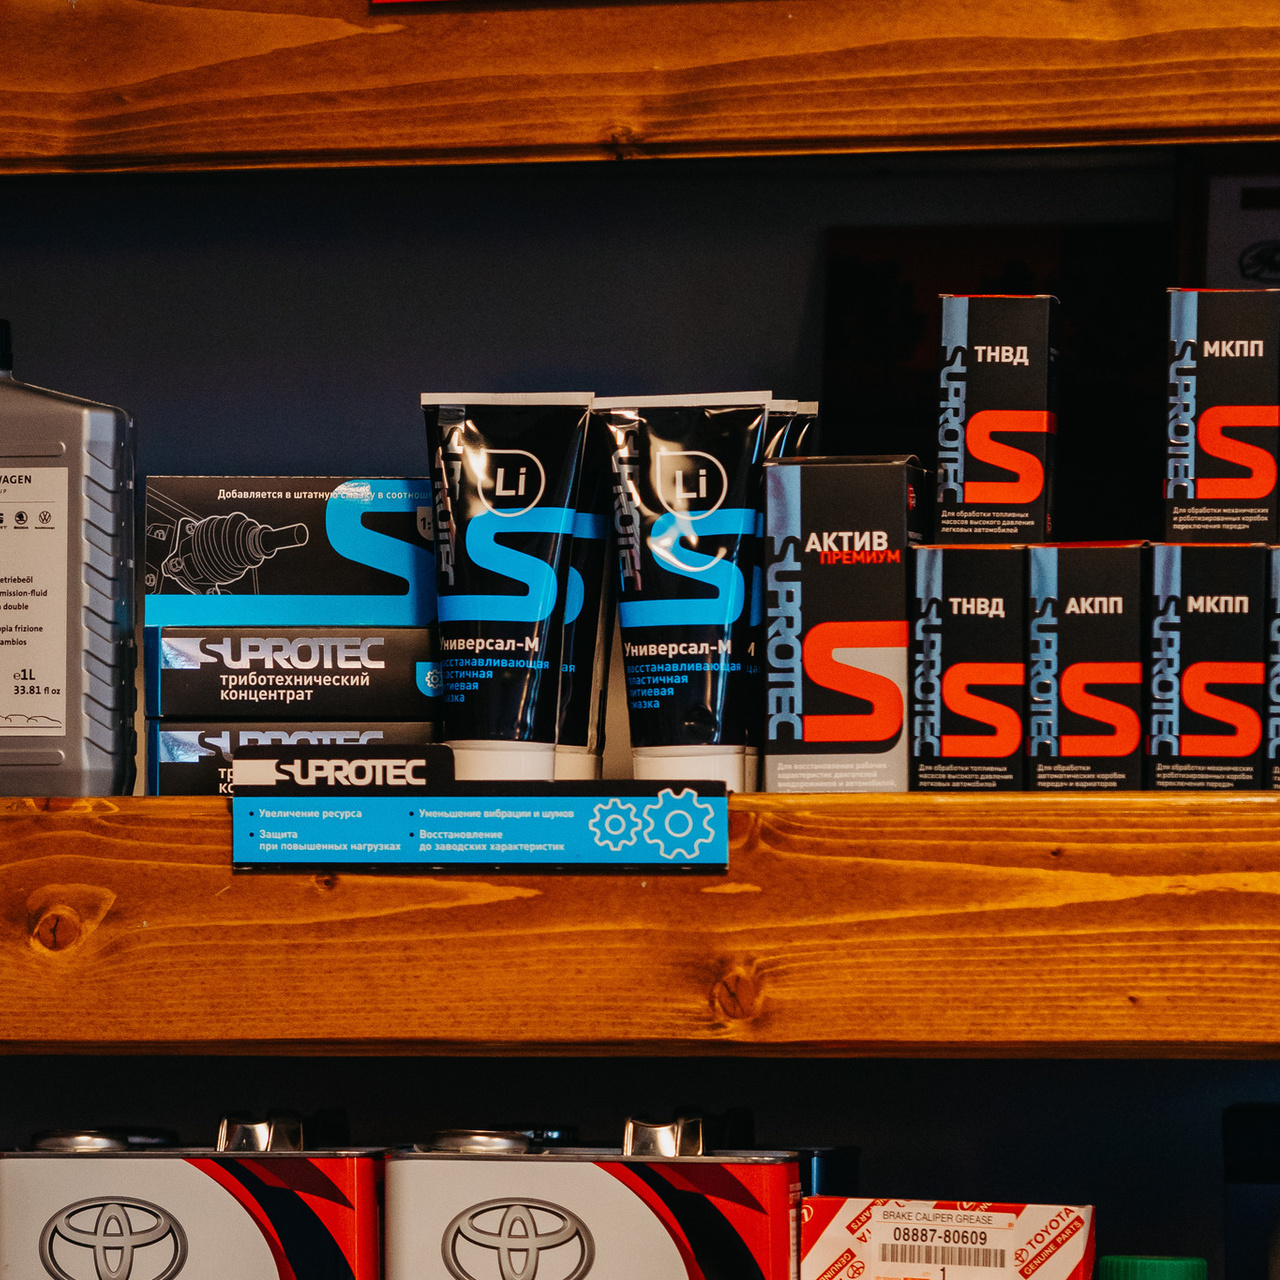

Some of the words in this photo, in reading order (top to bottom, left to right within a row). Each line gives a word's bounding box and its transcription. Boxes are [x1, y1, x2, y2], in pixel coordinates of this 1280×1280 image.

[974, 346, 1029, 366] ТНВД
[1203, 340, 1264, 358] МКПП
[495, 467, 527, 497] Li
[674, 468, 707, 499] Li
[218, 489, 282, 500] Добавляется
[294, 491, 338, 501] штатную
[805, 531, 888, 553] АКТИВ
[820, 549, 901, 564] ПРЕМИУМ
[949, 596, 1005, 618] ТНВД
[1065, 596, 1123, 615] АКПП
[1187, 596, 1249, 614] МКПП
[200, 637, 385, 670] SUPROTEC
[624, 640, 732, 658] Универсал-М
[220, 673, 370, 686] триботехнический
[14, 686, 41, 695] 33.81
[220, 689, 313, 703] концентрат
[275, 759, 427, 786] SUPROTEC
[259, 809, 319, 818] Увеличение
[323, 811, 362, 820] ресурса
[260, 830, 297, 840] Защита
[419, 830, 502, 839] Восстановление
[260, 843, 278, 852] при
[281, 843, 347, 851] повышенных
[351, 843, 401, 852] нагрузках
[419, 843, 431, 852] до
[434, 843, 487, 852] заводских
[883, 1211, 915, 1220] BRAKE
[918, 1212, 953, 1222] CALIPER
[956, 1215, 992, 1225] GREASE
[894, 1227, 987, 1245] 08887-80609
[1026, 1207, 1075, 1250] TOYOTA
[1023, 1235, 1061, 1277] GENUINE
[1056, 1219, 1083, 1247] PARTS
